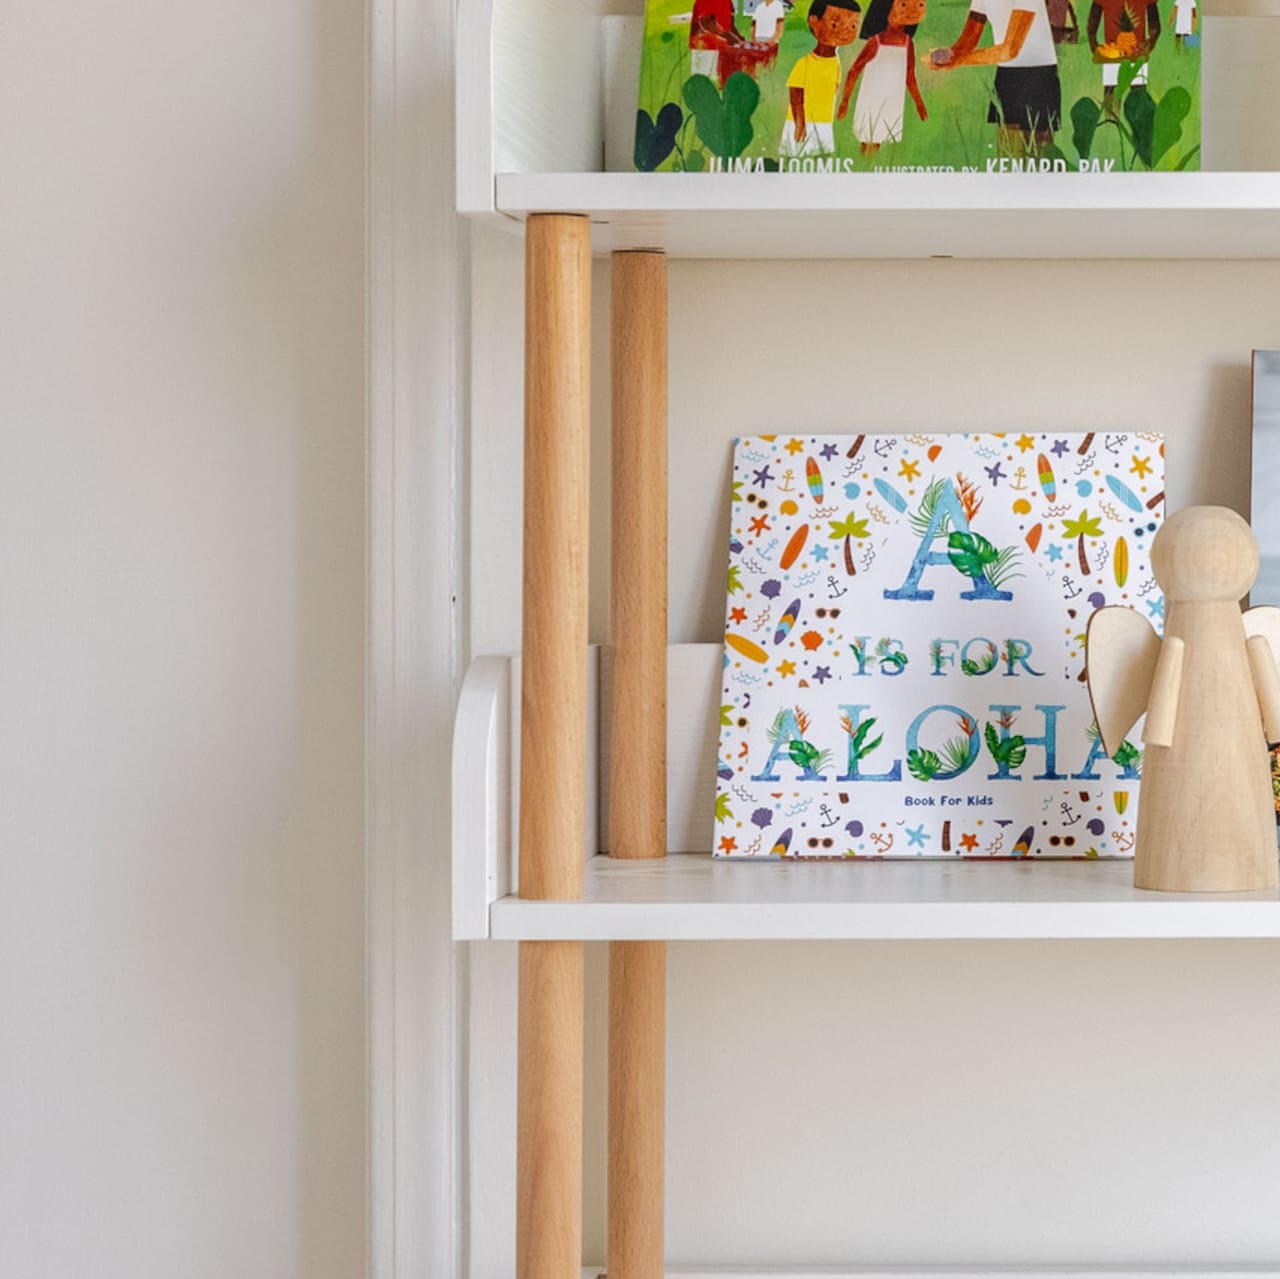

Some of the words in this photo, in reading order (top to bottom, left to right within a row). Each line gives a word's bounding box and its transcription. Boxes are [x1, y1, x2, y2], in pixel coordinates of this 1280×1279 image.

[882, 477, 1014, 601] A
[849, 635, 908, 676] IS
[930, 637, 1046, 677] FOR
[904, 795, 936, 807] Book
[940, 795, 963, 807] For
[966, 794, 994, 807] Kids
